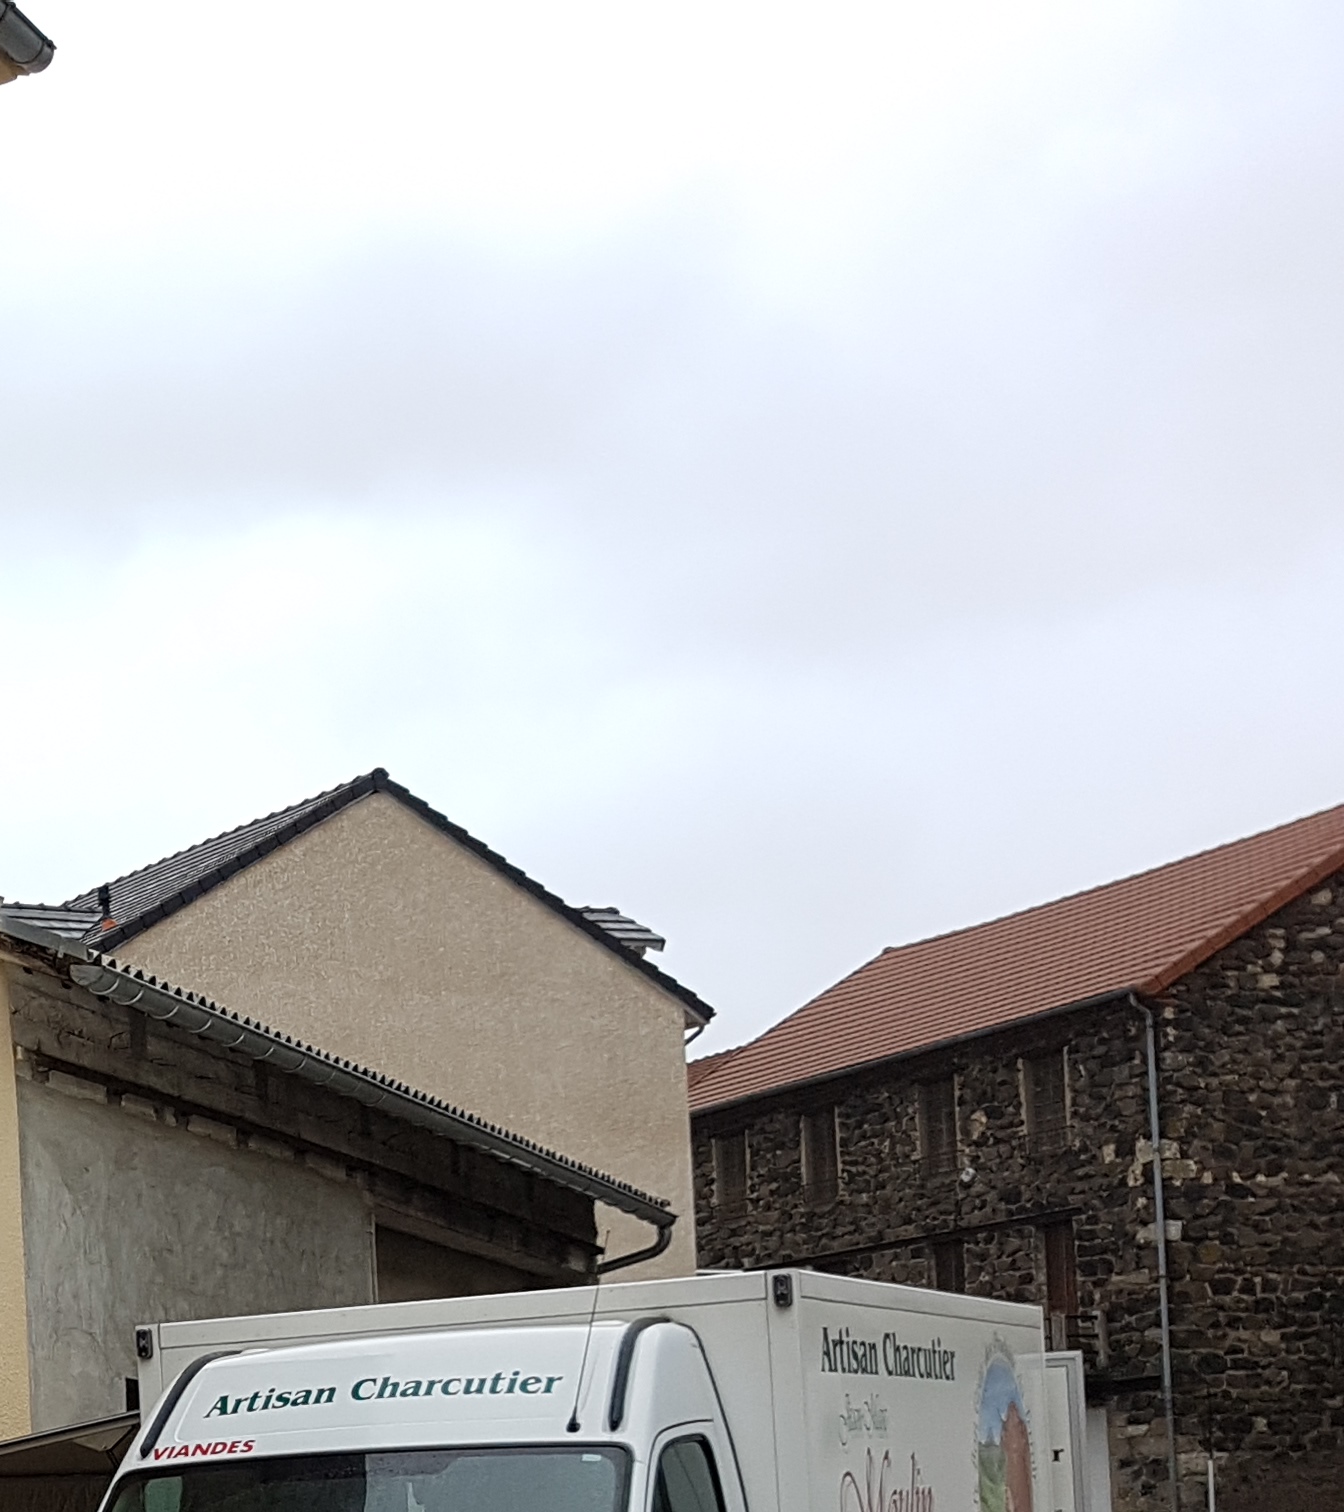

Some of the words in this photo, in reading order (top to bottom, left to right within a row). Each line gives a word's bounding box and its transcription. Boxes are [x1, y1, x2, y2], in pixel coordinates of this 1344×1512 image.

[820, 1326, 879, 1375] Artisan
[882, 1330, 955, 1381] Charcutier
[203, 1381, 337, 1419] Artisan
[350, 1369, 564, 1401] Charcutier
[152, 1439, 256, 1461] VIANDES
